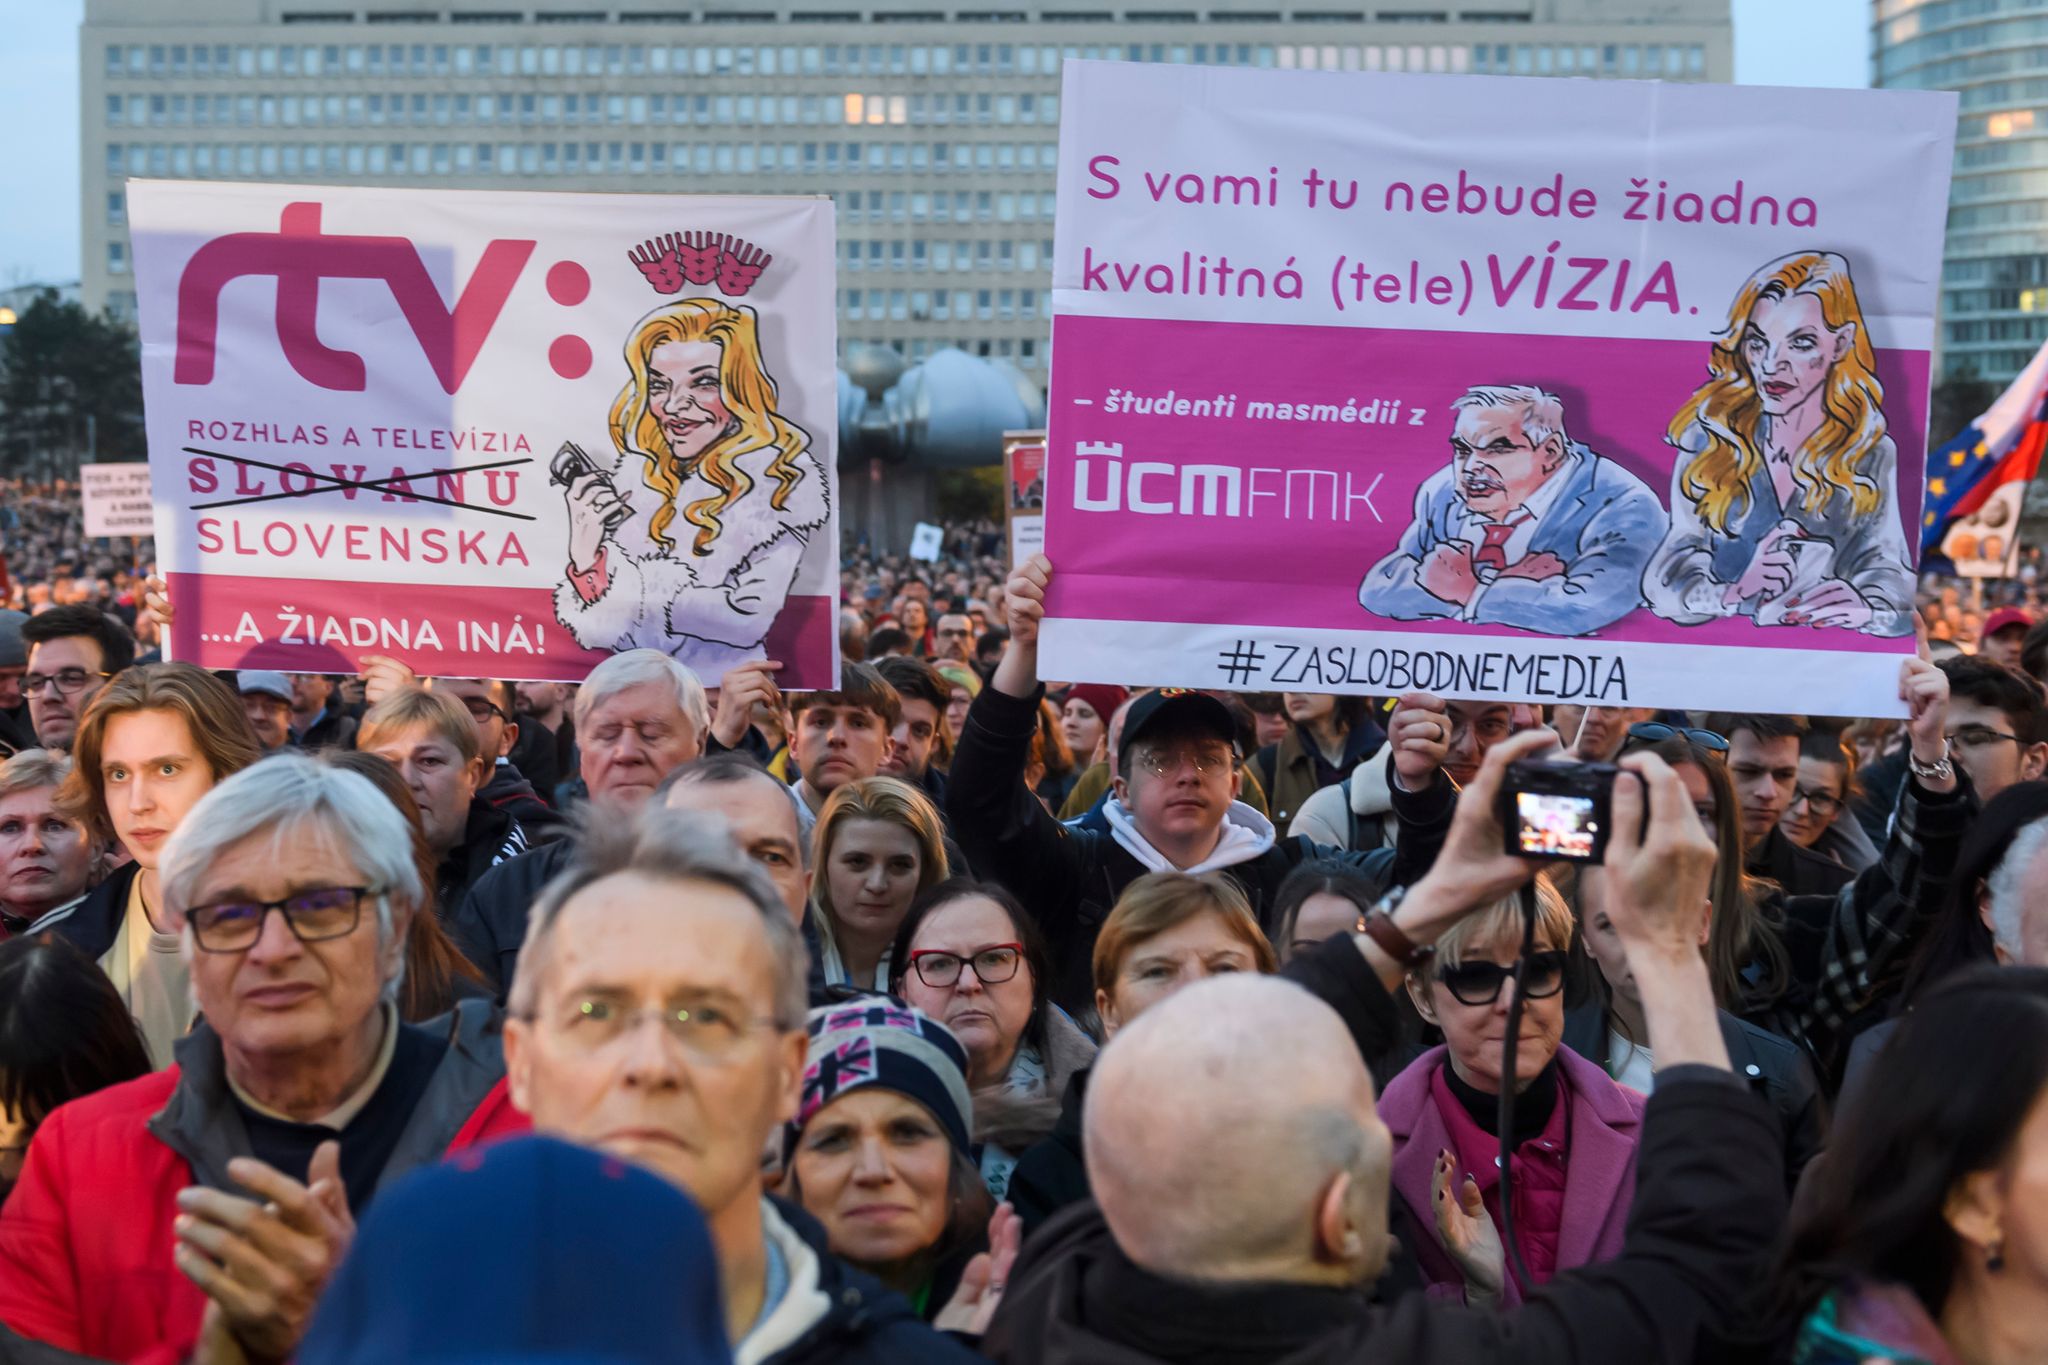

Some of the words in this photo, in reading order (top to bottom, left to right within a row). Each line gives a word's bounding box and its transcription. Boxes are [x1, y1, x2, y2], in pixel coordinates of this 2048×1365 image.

[1087, 155, 1121, 200] S
[1144, 166, 1278, 207] vami
[1302, 168, 1358, 210] tu
[1384, 169, 1598, 219] nebude
[1623, 177, 1818, 227] žiadna
[1082, 246, 1303, 299] kvalitná
[1103, 388, 1237, 418] študenti
[1246, 397, 1402, 425] masmédií
[1408, 407, 1427, 426] z
[188, 419, 328, 446] ROZHLAS
[342, 427, 361, 447] A
[371, 425, 532, 453] TELEVÍZIA
[187, 457, 520, 507] SLOVANU
[196, 517, 530, 567] SLOVENSKA
[276, 605, 443, 651] ŽIADNA
[458, 614, 546, 655] INÁ!
[1217, 639, 1629, 702] #ZASLOBODNEMEDIA
